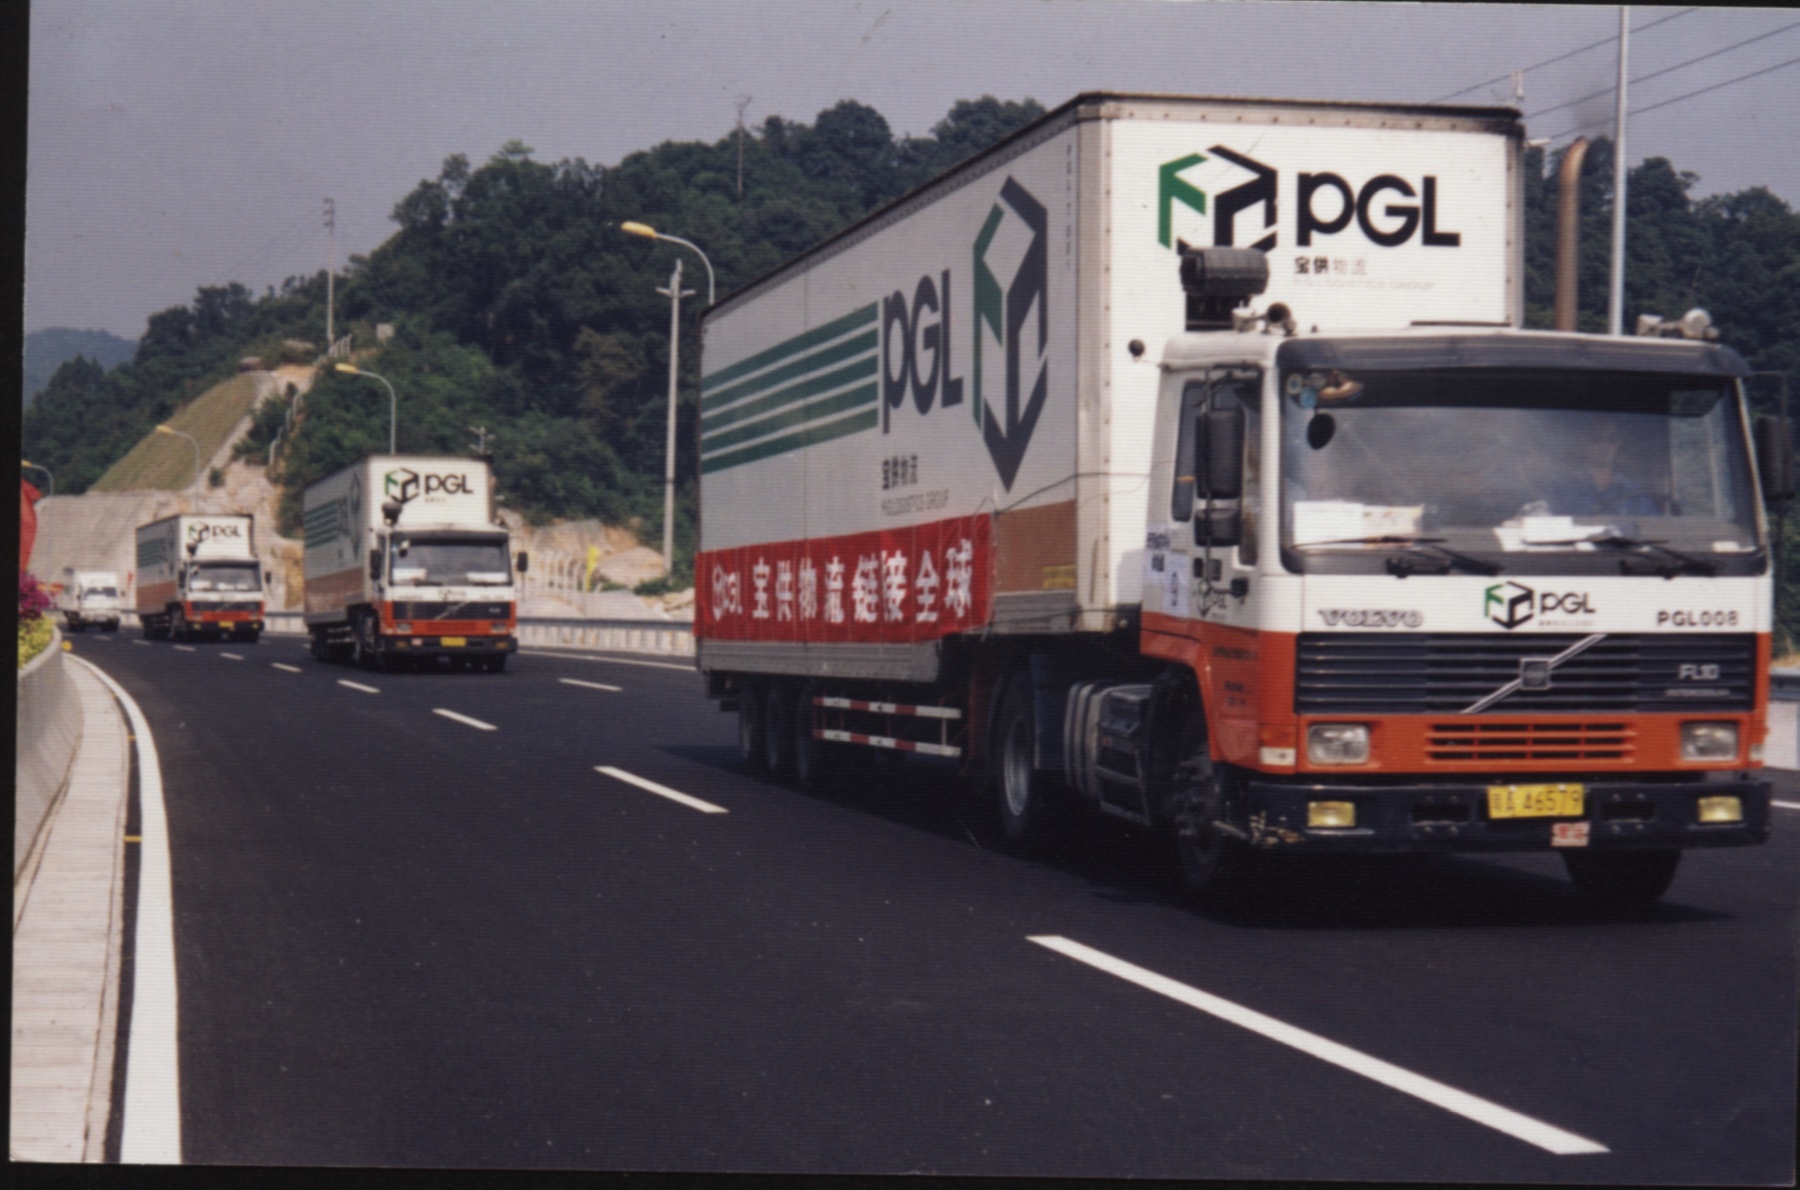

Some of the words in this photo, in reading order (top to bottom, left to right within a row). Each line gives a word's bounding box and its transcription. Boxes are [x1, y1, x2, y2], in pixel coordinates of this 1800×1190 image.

[1296, 171, 1461, 247] PGL
[882, 268, 963, 434] PGL
[425, 474, 473, 495] PGL
[1540, 592, 1596, 614] PGL
[1318, 609, 1423, 628] VOLVO
